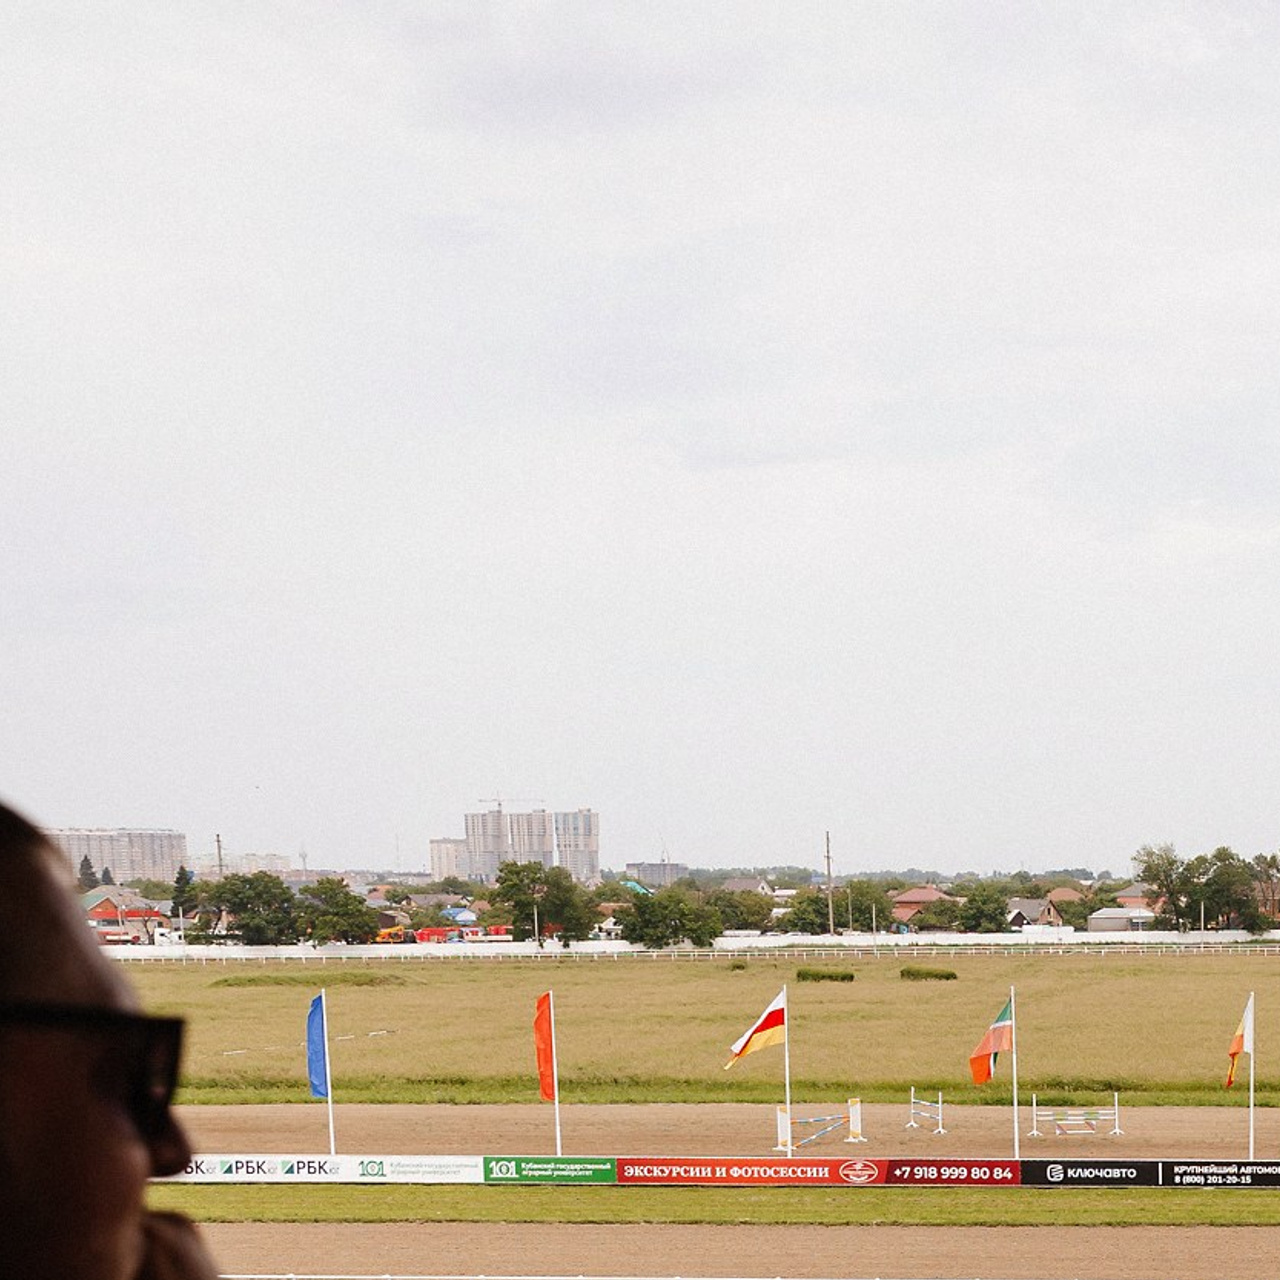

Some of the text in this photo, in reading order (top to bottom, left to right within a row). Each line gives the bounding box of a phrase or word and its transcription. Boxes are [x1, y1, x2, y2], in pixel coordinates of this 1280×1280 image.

[184, 1160, 206, 1175] БК
[235, 1160, 267, 1175] РБК
[296, 1160, 329, 1175] РБК
[624, 1165, 712, 1178] ЭКСКУРСИИ
[715, 1166, 727, 1178] И
[729, 1166, 829, 1179] ФОТОСЕССИИ
[894, 1166, 1013, 1180] +7 918 999 80 84
[1174, 1164, 1238, 1175] КРУПНЕЙШИЙ
[1174, 1174, 1251, 1185] 8 (800) 201-20-15
